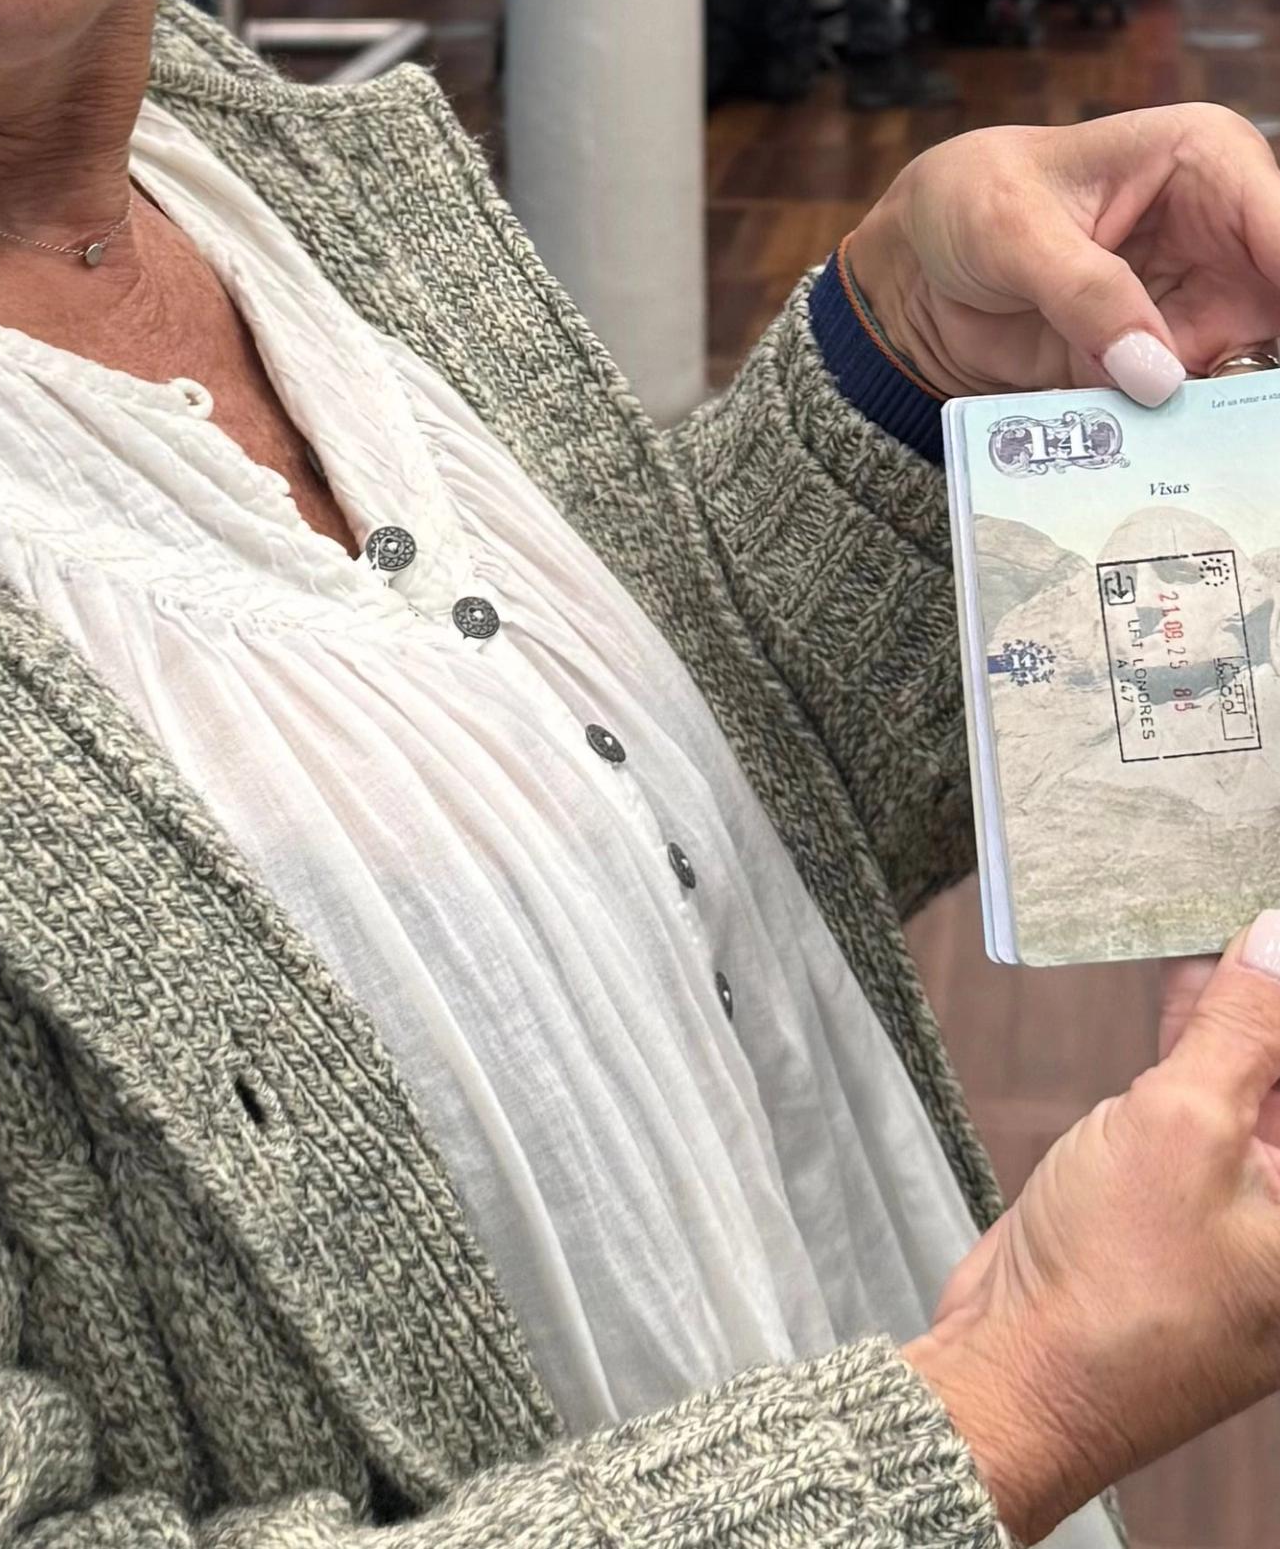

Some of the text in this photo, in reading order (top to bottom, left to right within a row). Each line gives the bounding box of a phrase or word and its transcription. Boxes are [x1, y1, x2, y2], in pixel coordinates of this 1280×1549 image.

[1211, 395, 1225, 408] Let
[1025, 418, 1095, 464] 14
[1149, 481, 1191, 496] Visas
[1205, 565, 1223, 578] F
[1011, 654, 1033, 669] 14
[1116, 659, 1128, 669] A
[1132, 658, 1156, 741] LONDRES
